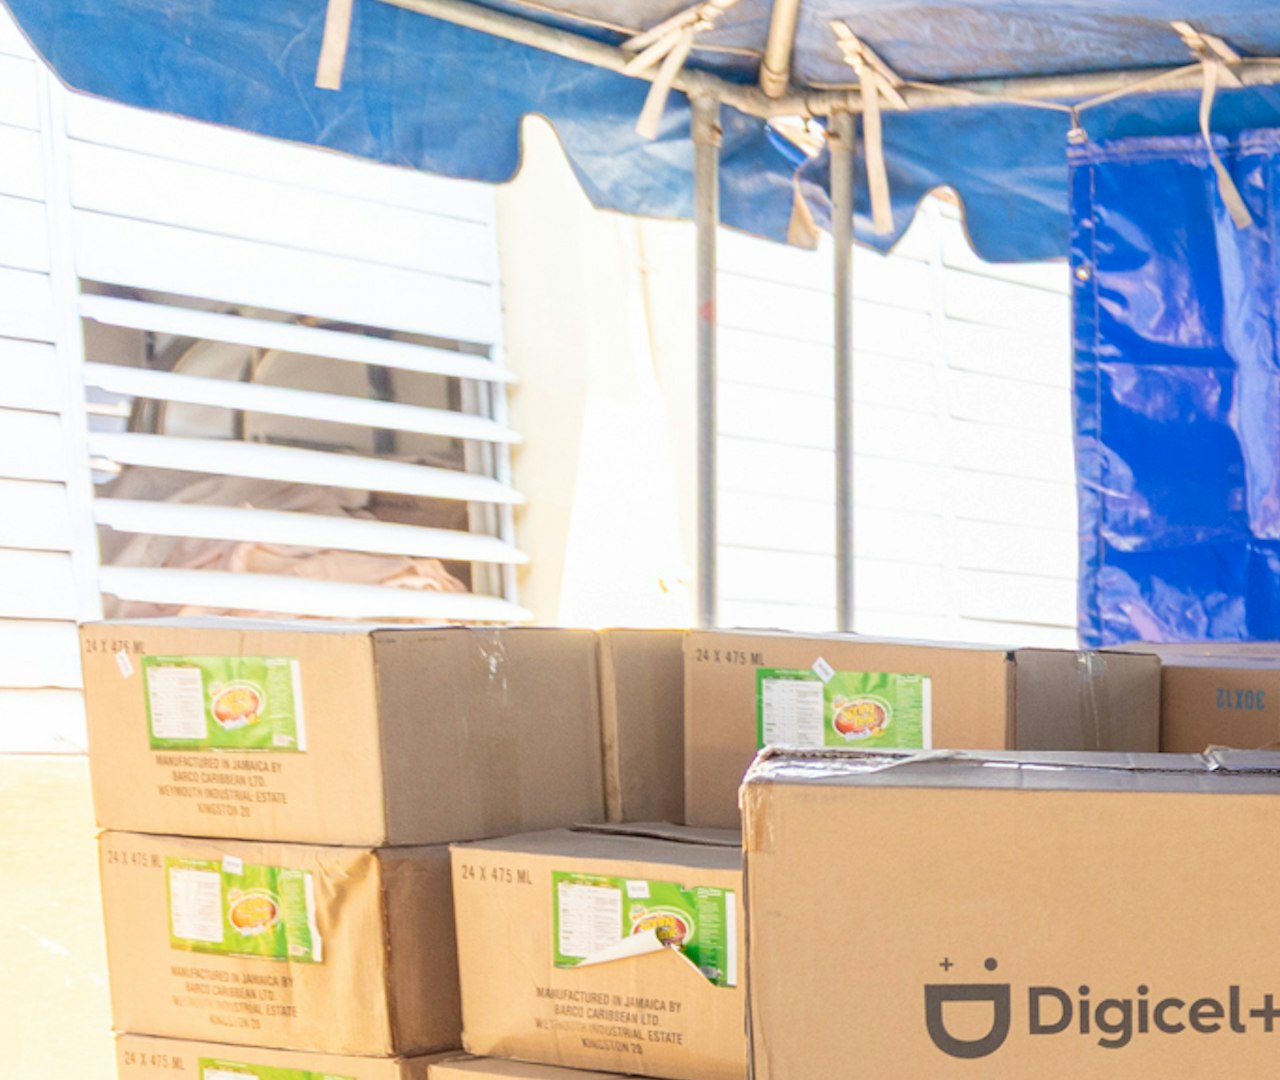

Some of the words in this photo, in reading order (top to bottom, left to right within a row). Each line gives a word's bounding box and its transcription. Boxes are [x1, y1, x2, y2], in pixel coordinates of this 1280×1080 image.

[87, 640, 98, 653] 24
[102, 640, 107, 652] X
[697, 650, 709, 662] 24
[714, 650, 720, 663] X
[726, 652, 746, 664] 475
[751, 652, 764, 665] ML
[156, 755, 219, 769] MANUFACTURED
[222, 760, 230, 769] IN
[232, 761, 269, 772] JAMAICA
[272, 762, 282, 773] BY
[201, 773, 246, 786] CARIBBEAN
[256, 792, 288, 804] ESTATE
[108, 850, 118, 864] 24
[132, 852, 148, 867] 475
[461, 865, 475, 880] 24
[480, 868, 486, 881] X
[492, 868, 513, 883] 475
[517, 870, 533, 885] ML
[242, 974, 278, 986] JAMAICA
[281, 976, 293, 988] BY
[536, 987, 610, 1005] MANUFACTURED
[612, 995, 621, 1006] IN
[624, 996, 666, 1011] JAMAICA
[669, 1001, 681, 1013] BY
[266, 1005, 296, 1018] ESTATE
[587, 1008, 638, 1023] CARIBBEAN
[648, 1031, 683, 1045] ESTATE
[125, 1052, 136, 1064] 24
[141, 1053, 146, 1065] X
[152, 1055, 168, 1068] 475
[173, 1056, 185, 1070] ML
